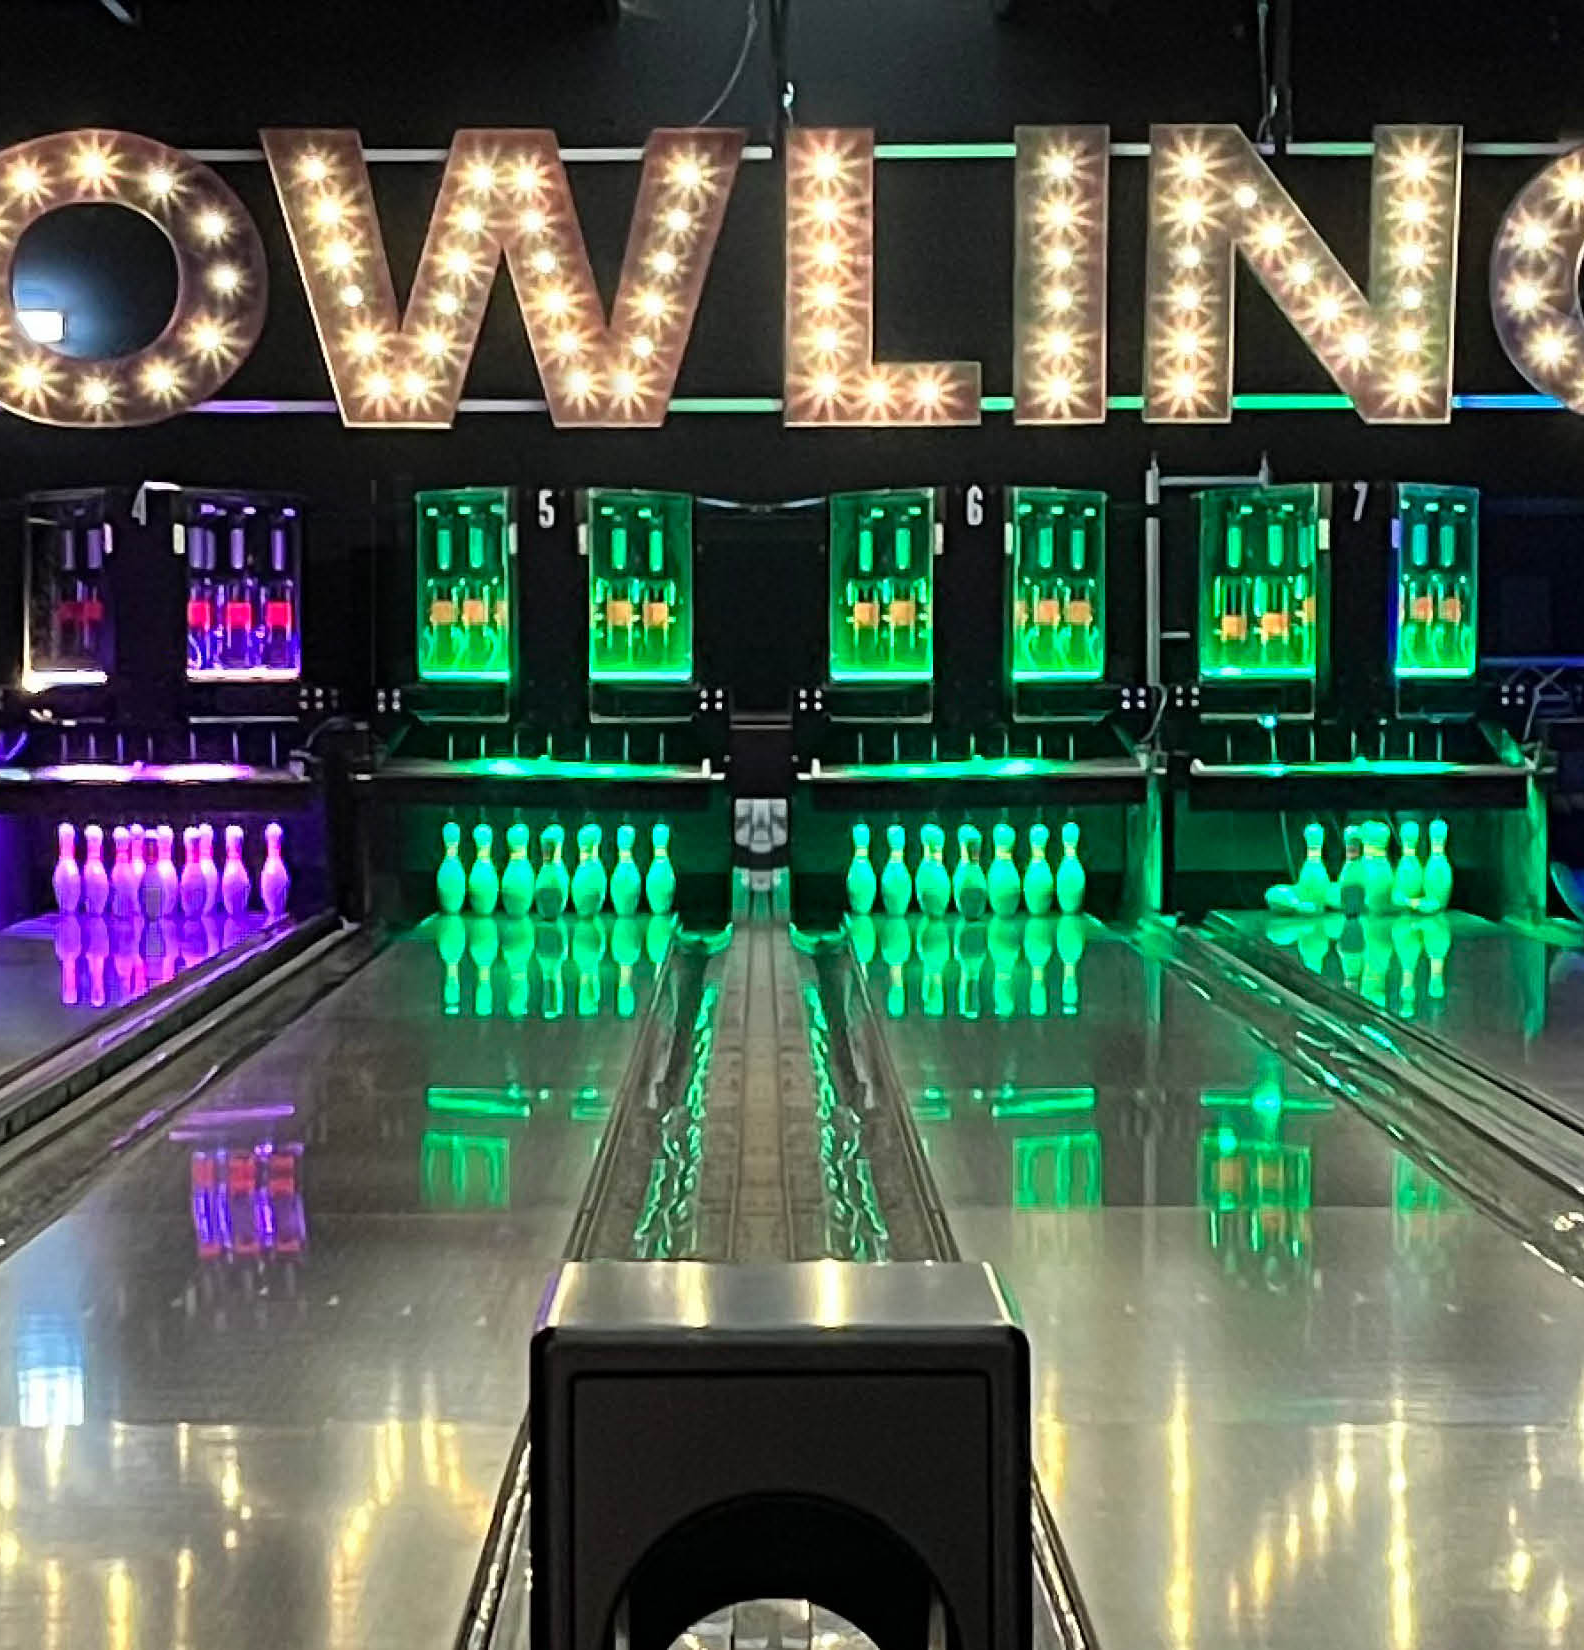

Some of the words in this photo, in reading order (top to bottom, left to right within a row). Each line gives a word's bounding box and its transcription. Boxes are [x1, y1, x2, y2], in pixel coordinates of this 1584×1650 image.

[130, 482, 147, 526] 4
[537, 488, 555, 528] 5
[966, 484, 984, 526] 6
[1353, 481, 1370, 522] 7
